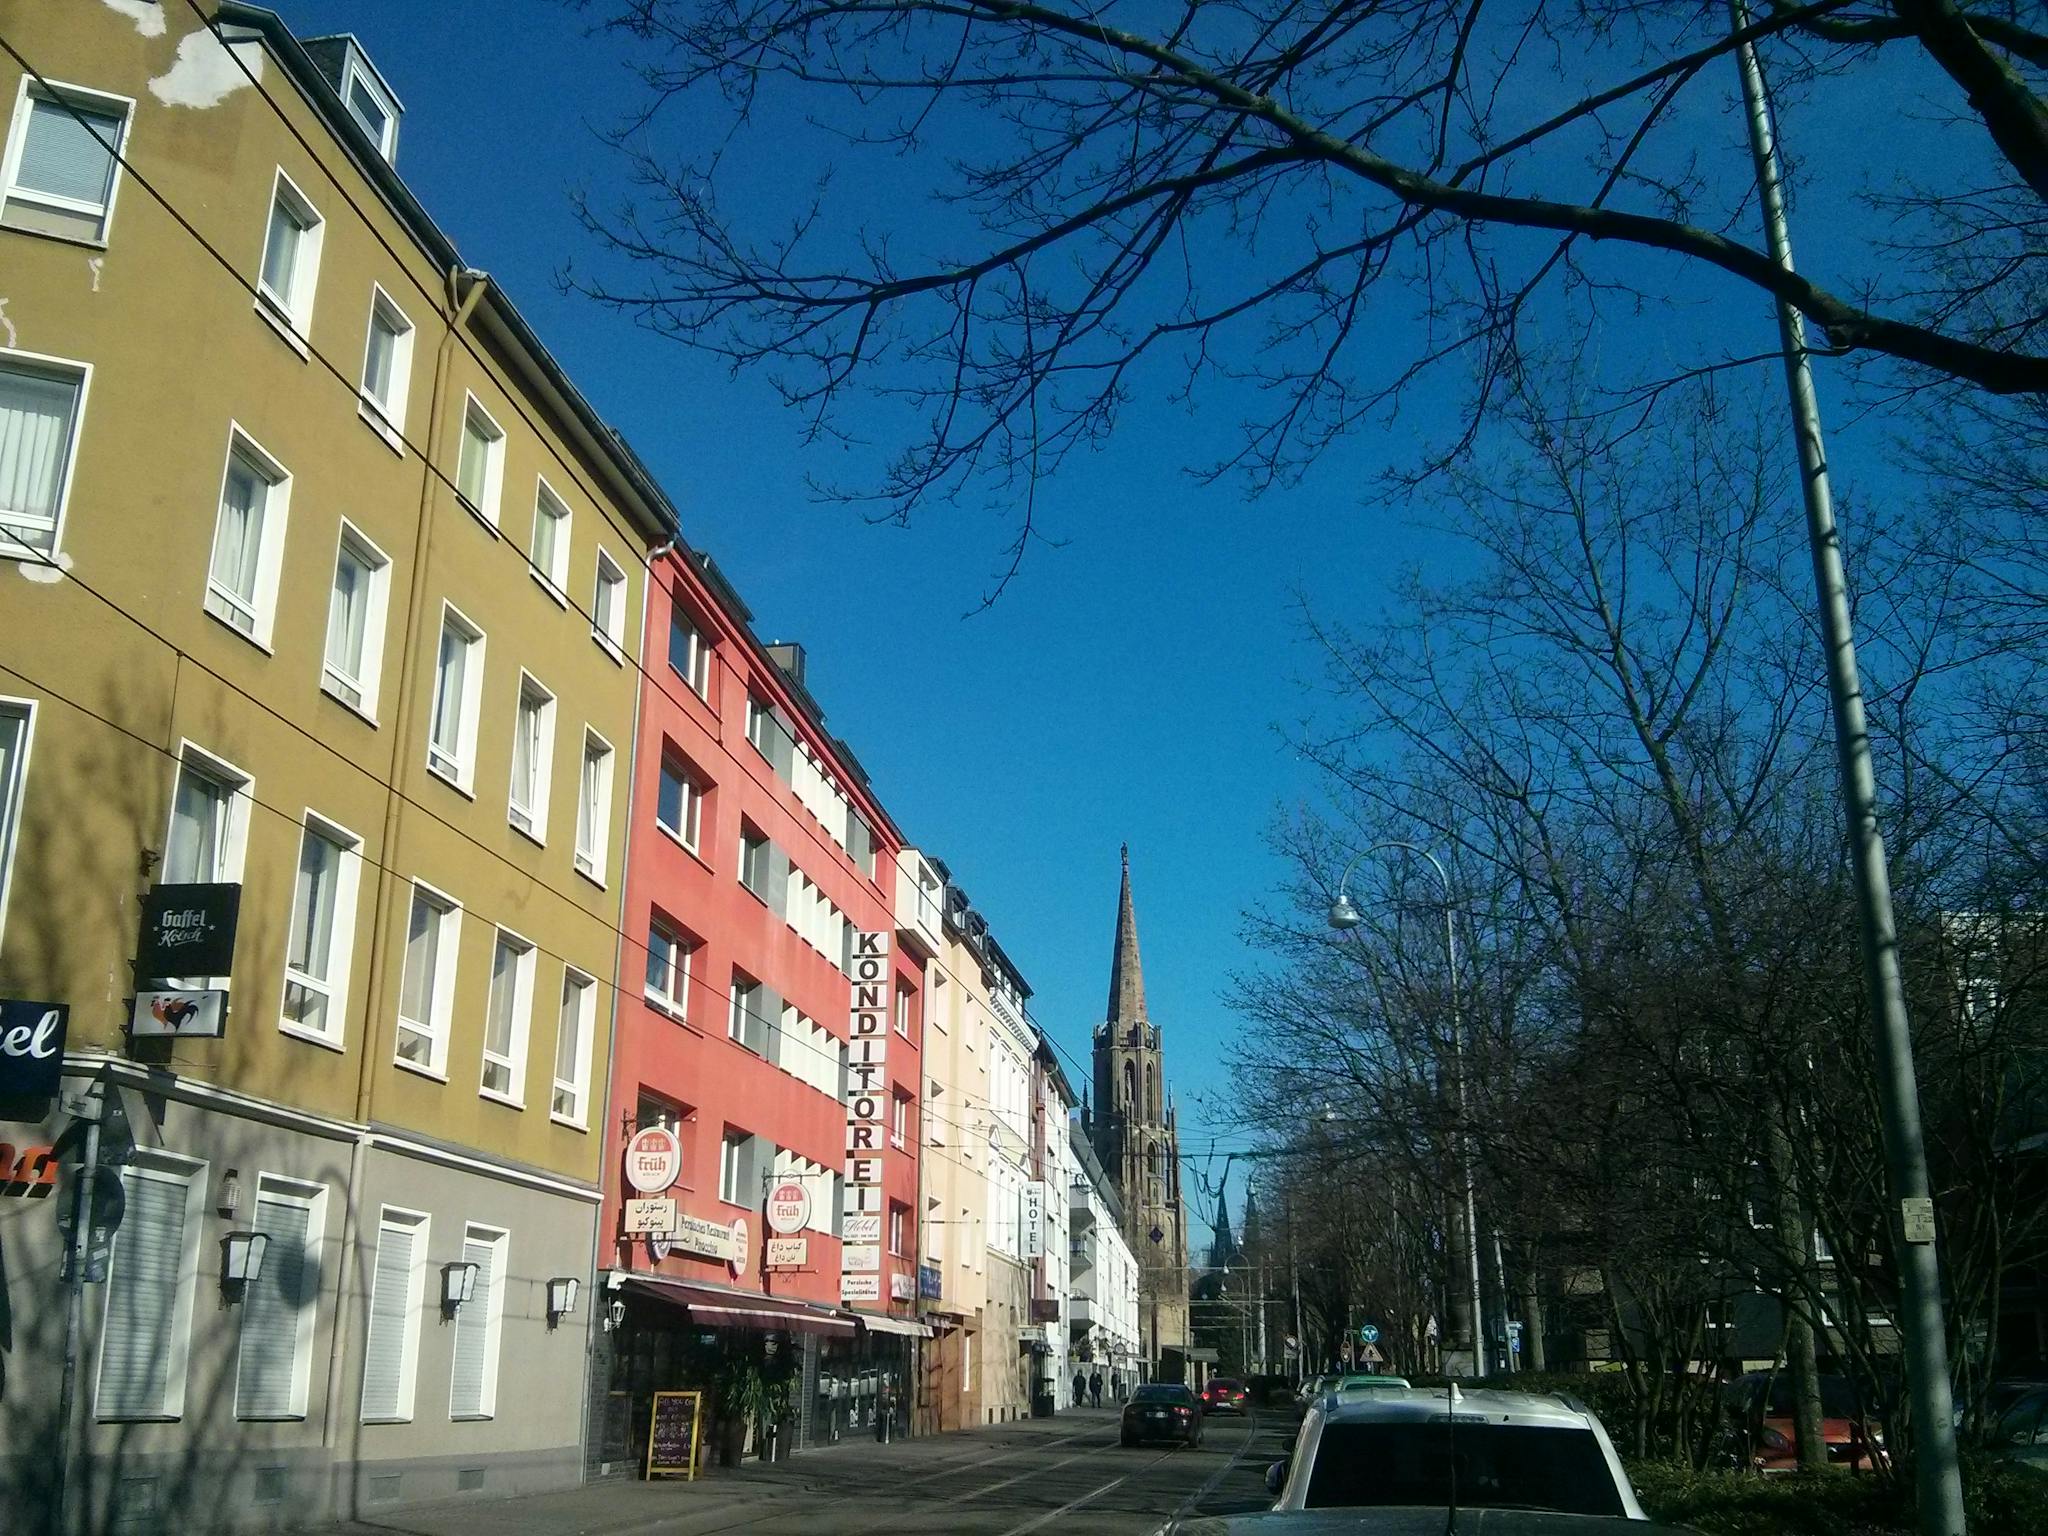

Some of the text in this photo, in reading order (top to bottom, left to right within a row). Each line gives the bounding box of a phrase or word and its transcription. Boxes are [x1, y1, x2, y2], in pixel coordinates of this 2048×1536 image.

[161, 909, 206, 928] Gaffel
[157, 928, 204, 947] Kölsch
[0, 1004, 60, 1058] el
[853, 933, 880, 1210] KONDITOREI
[637, 1155, 667, 1173] früh
[635, 1202, 668, 1214] رستوران
[776, 1204, 800, 1218] früh
[1028, 1197, 1038, 1254] HOTEL
[841, 1289, 877, 1297] Spezialitäten
